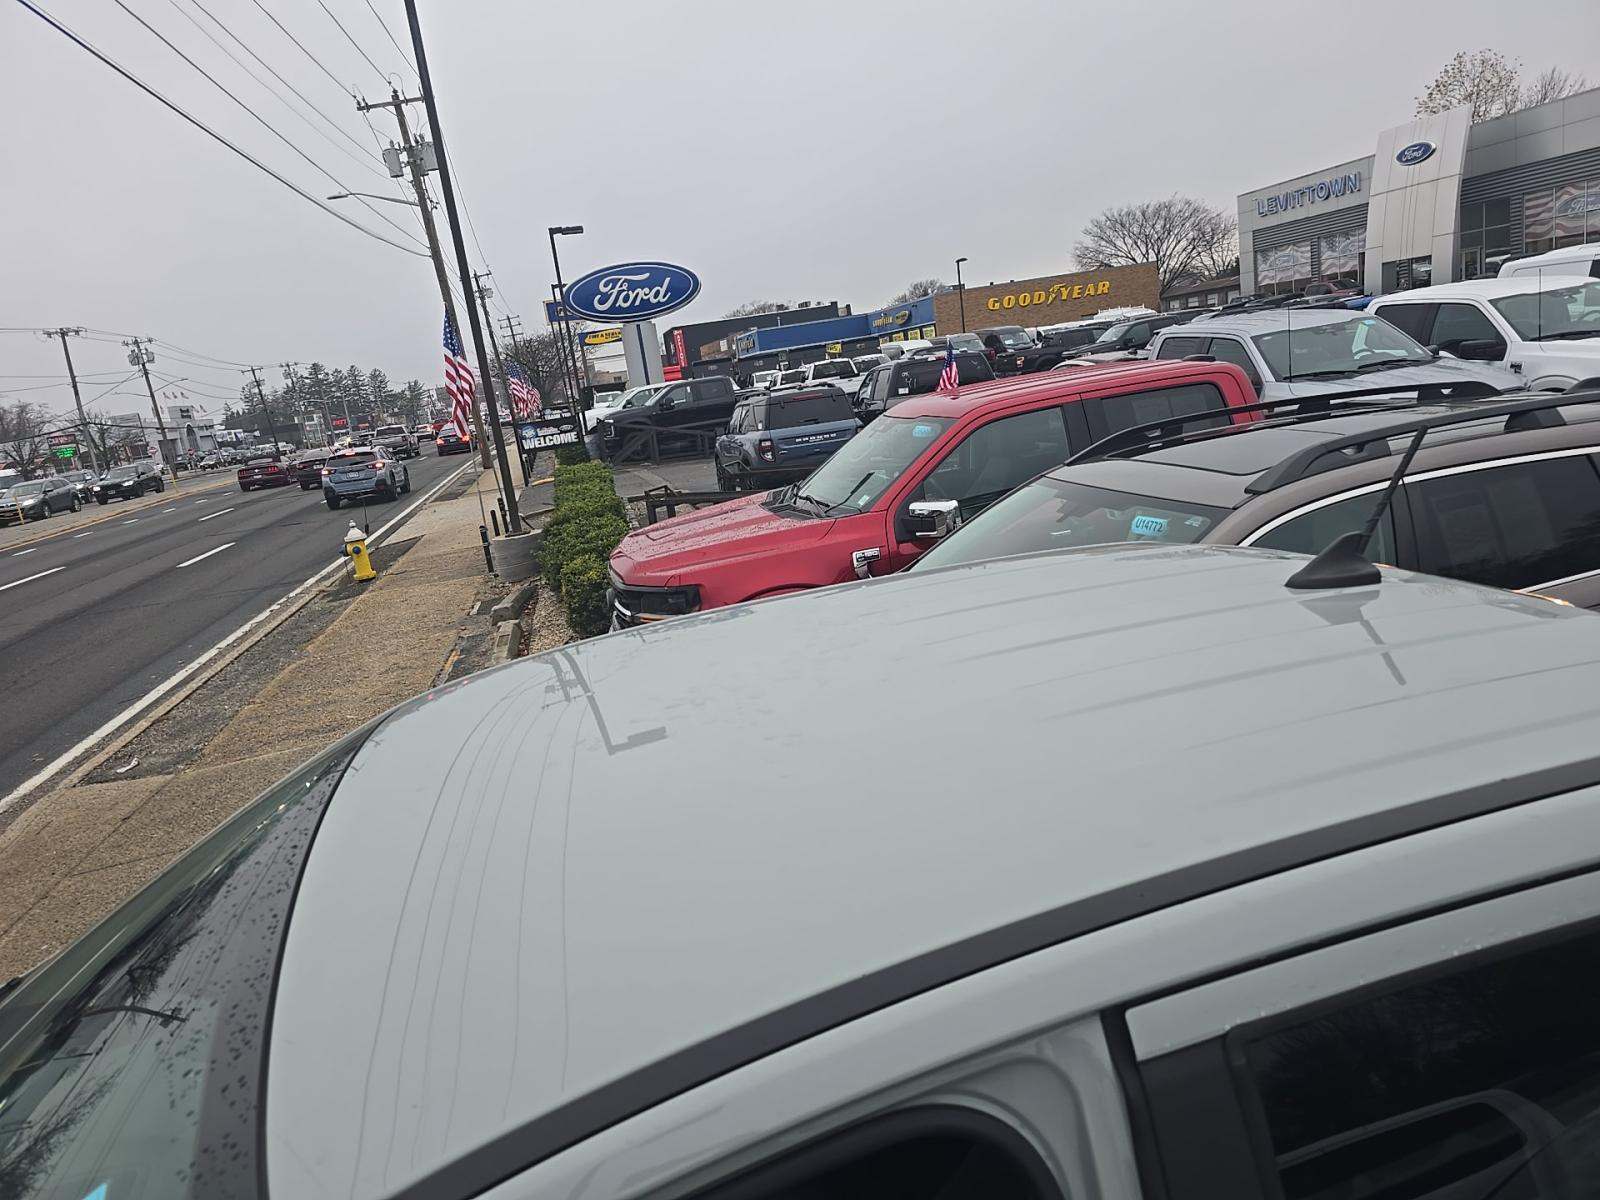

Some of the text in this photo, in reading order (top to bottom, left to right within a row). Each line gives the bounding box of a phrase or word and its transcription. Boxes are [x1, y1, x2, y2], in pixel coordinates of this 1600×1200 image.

[1257, 171, 1361, 217] LEVITTOWN
[593, 273, 671, 311] Ford
[522, 432, 579, 450] WELCOME
